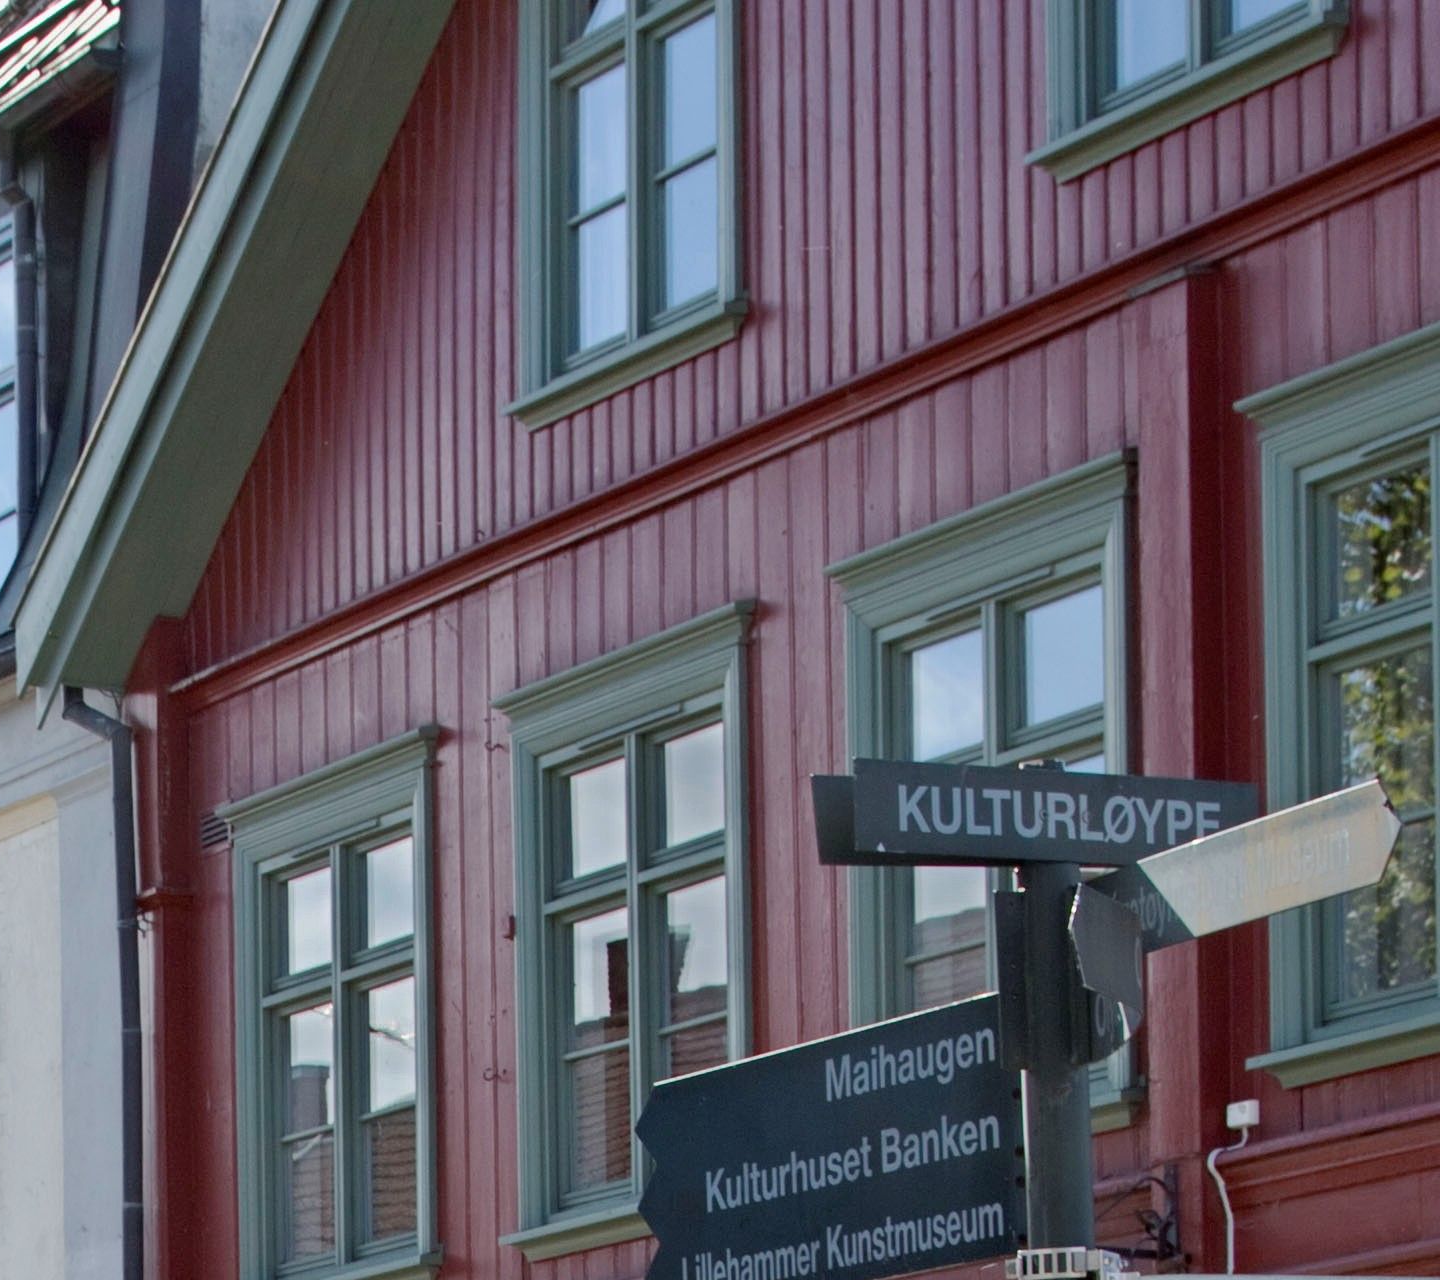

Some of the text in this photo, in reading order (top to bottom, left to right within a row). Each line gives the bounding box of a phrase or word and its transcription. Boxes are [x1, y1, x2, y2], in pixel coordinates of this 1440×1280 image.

[825, 1027, 996, 1102] Maihaugen
[705, 1114, 1000, 1213] Kulturhuset Banken
[826, 1202, 1004, 1270] Kunstmuseum
